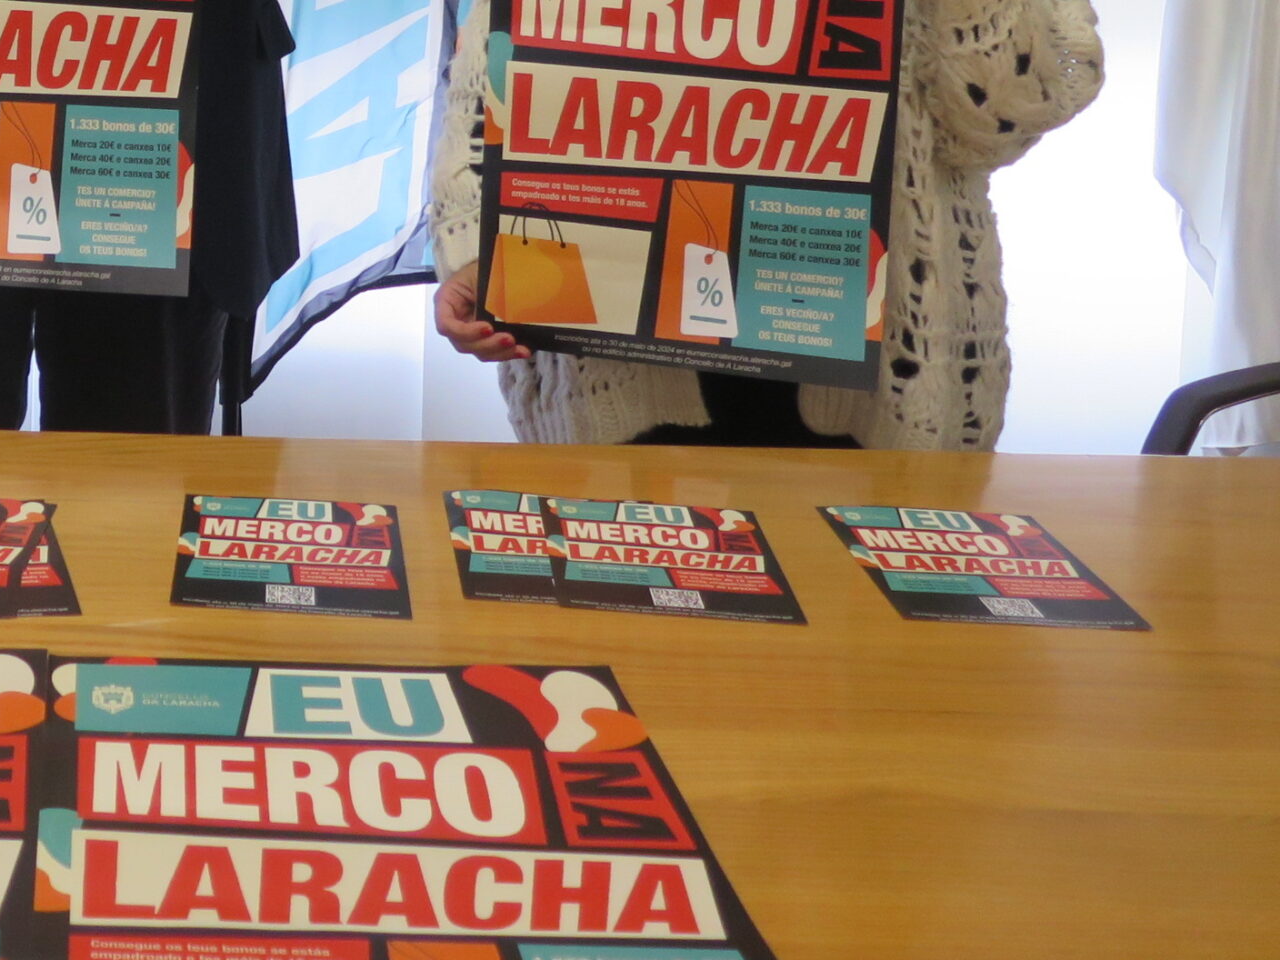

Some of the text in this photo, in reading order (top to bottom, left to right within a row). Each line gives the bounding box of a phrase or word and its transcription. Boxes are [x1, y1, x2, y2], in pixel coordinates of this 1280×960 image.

[70, 119, 175, 134] 1.333 bonos de 30€
[509, 72, 872, 177] LARACHA
[71, 139, 97, 148] Merca
[99, 141, 114, 149] 20€
[124, 143, 154, 151] canxea
[157, 144, 171, 152] 10€
[749, 200, 867, 220] 1.333 bonos de 30€
[750, 221, 778, 231] Merca
[782, 224, 798, 233] 20€
[809, 227, 842, 237] canxea
[846, 229, 862, 239] 10€
[749, 235, 778, 245] Merca
[781, 238, 797, 247] 40€
[808, 241, 841, 251] canxea
[845, 243, 861, 253] 20€
[749, 249, 777, 259] Merca
[780, 252, 796, 261] 60€
[807, 255, 840, 265] canxea
[843, 258, 860, 267] 30€
[266, 501, 326, 520] EU
[623, 504, 686, 523] EU
[908, 510, 971, 531] EU
[203, 517, 343, 544] MERCO
[566, 520, 709, 549] MERCO
[856, 528, 1009, 555] MERCO
[199, 541, 384, 566] LARACHA
[568, 544, 758, 571] LARACHA
[873, 553, 1071, 577] LARACHA
[269, 672, 446, 737] EU
[91, 740, 526, 838] MERCO
[560, 759, 680, 840] NA
[82, 838, 701, 935] LARACHA
